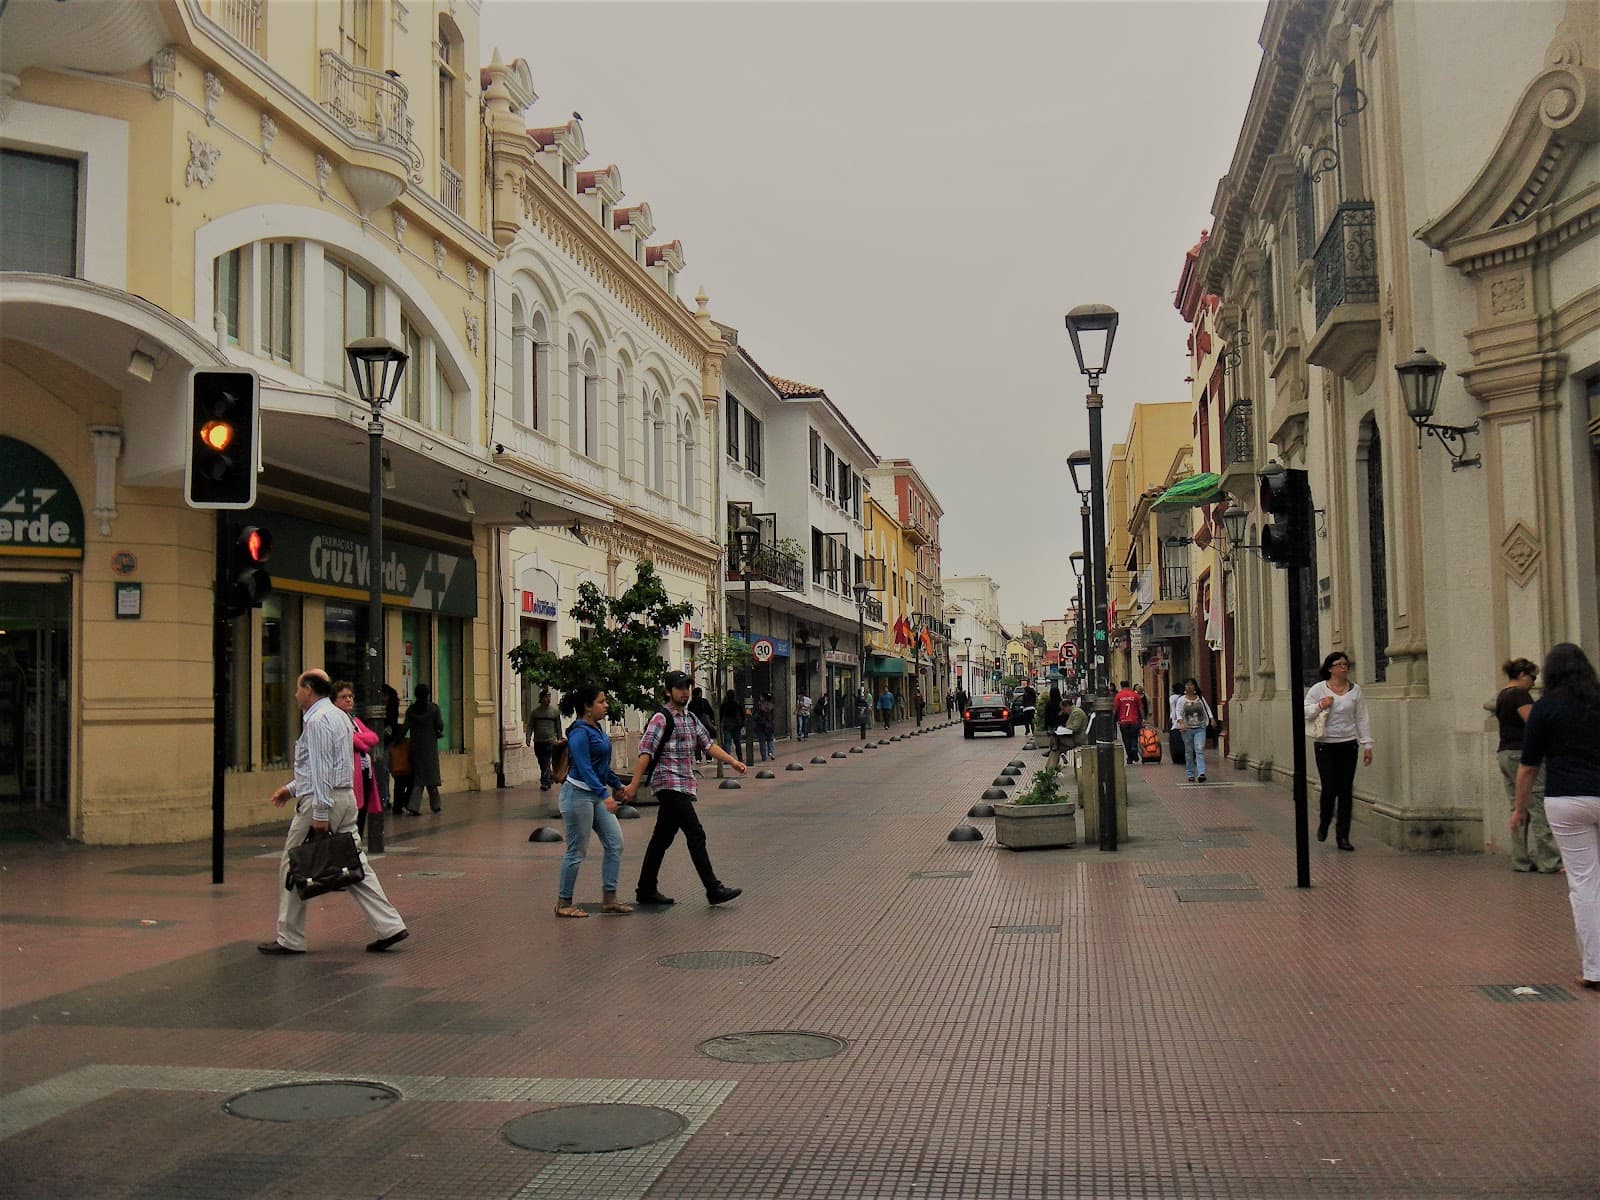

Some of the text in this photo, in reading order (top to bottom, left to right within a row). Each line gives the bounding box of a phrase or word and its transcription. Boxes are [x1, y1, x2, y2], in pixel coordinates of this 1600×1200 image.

[309, 535, 354, 585] Cruz
[756, 645, 770, 656] 30
[1125, 703, 1131, 717] 7
